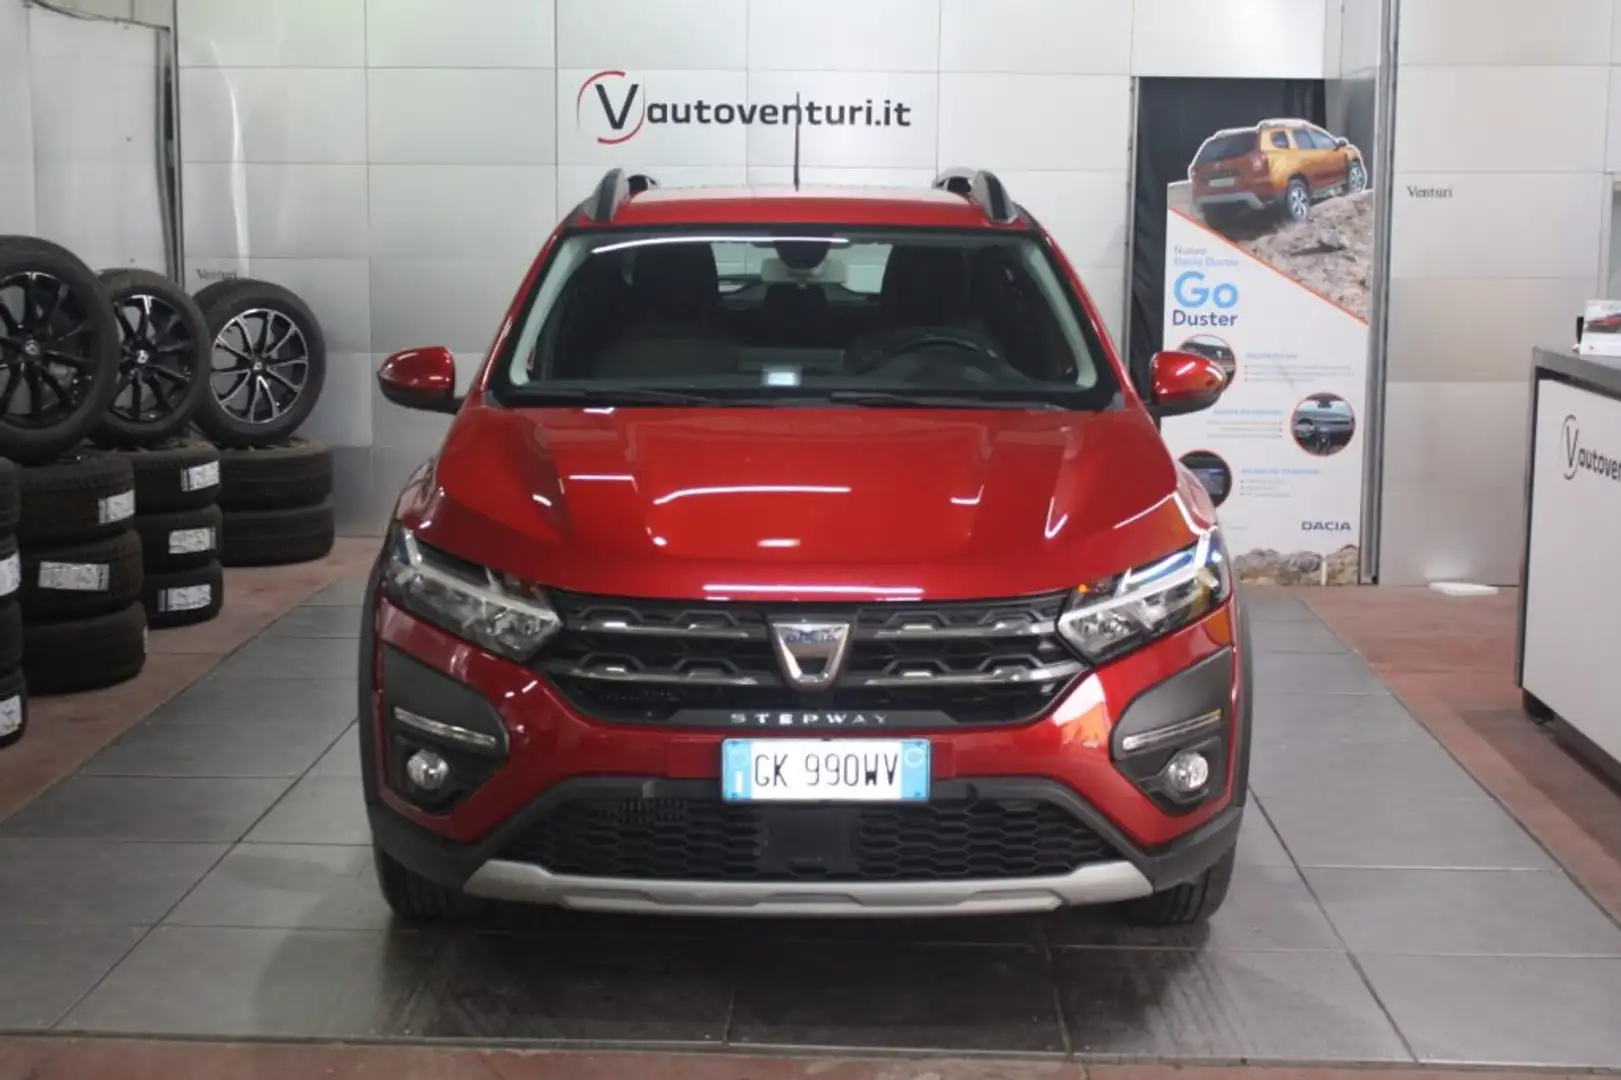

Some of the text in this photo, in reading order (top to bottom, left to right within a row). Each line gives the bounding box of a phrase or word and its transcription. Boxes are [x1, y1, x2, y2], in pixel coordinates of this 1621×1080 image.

[646, 100, 911, 127] autoventuri.it
[1406, 185, 1453, 198] Venturi
[1174, 270, 1238, 308] Go
[1172, 309, 1238, 326] Duster
[1301, 521, 1352, 531] DACIA
[730, 713, 888, 725] STEPWAY
[754, 753, 789, 787] GK
[805, 753, 898, 787] 990WV
